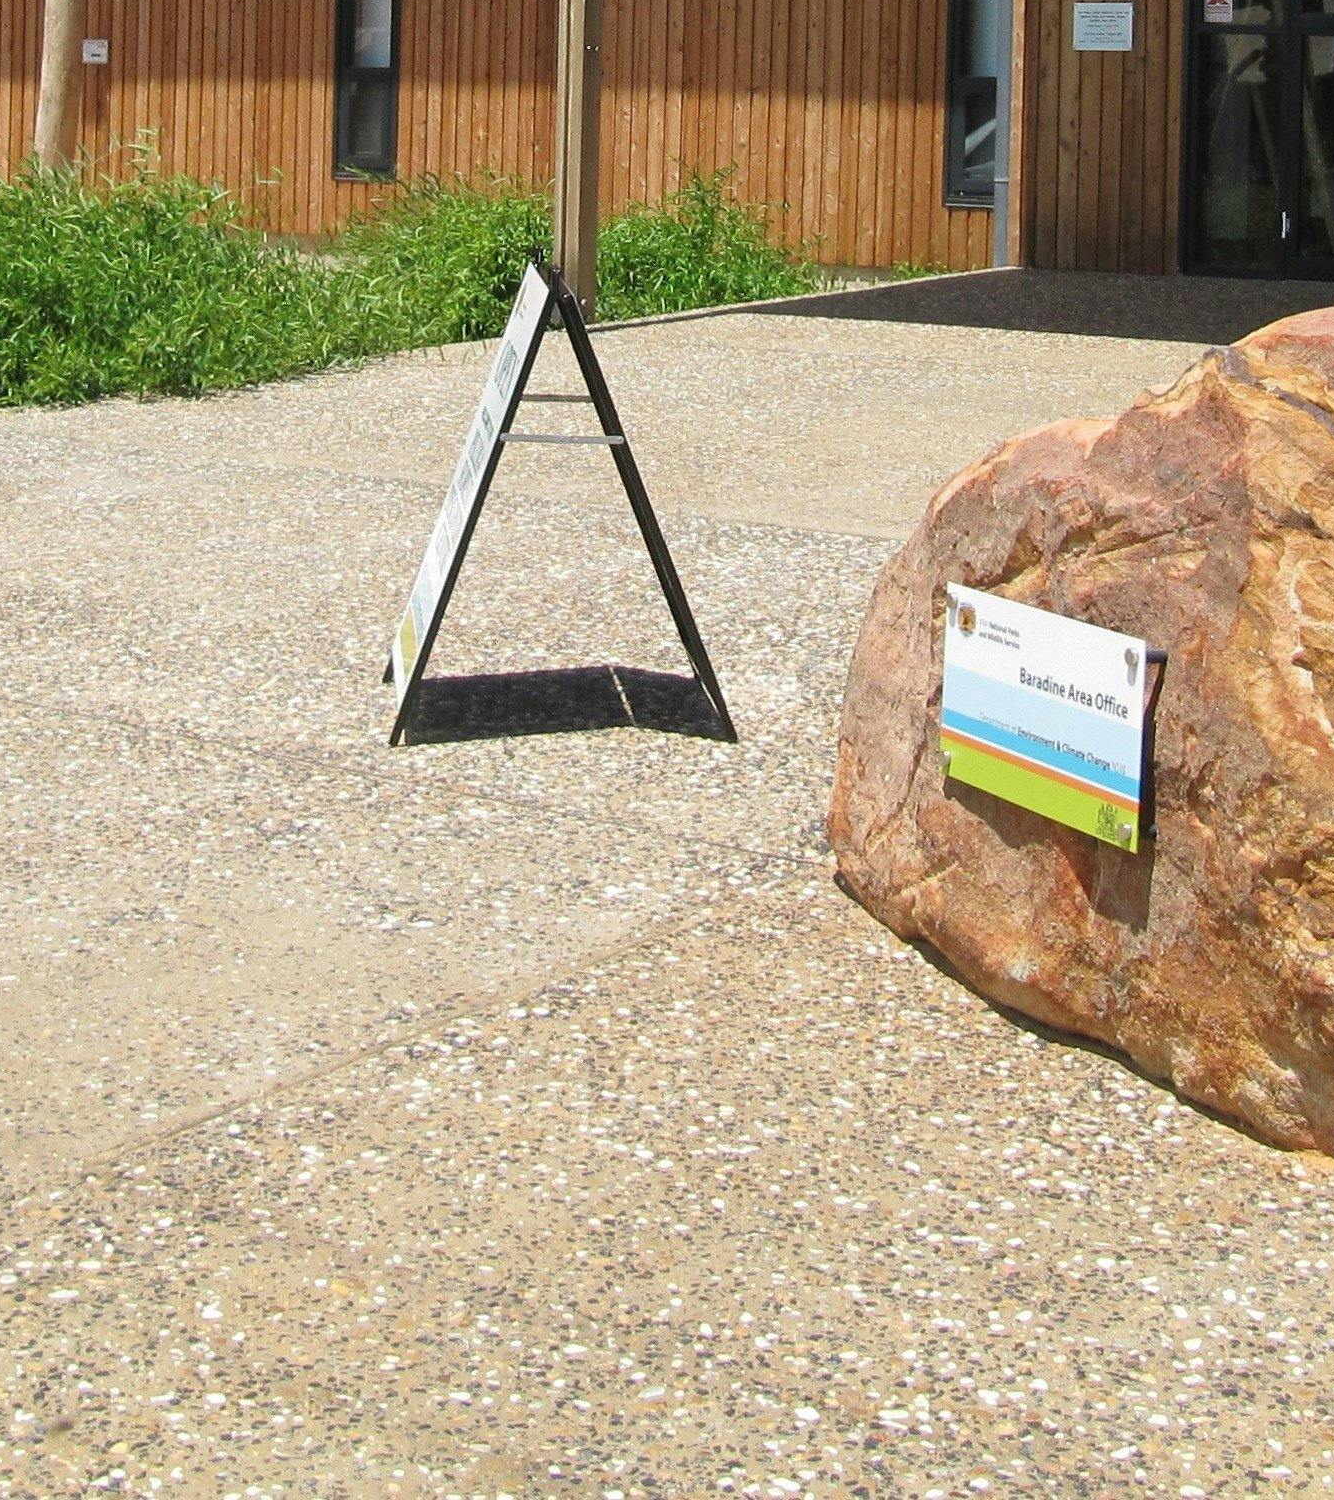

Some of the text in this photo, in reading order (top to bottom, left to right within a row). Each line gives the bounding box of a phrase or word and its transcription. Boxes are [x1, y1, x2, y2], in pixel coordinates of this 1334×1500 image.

[1019, 666, 1129, 719] Baradine Area Office
